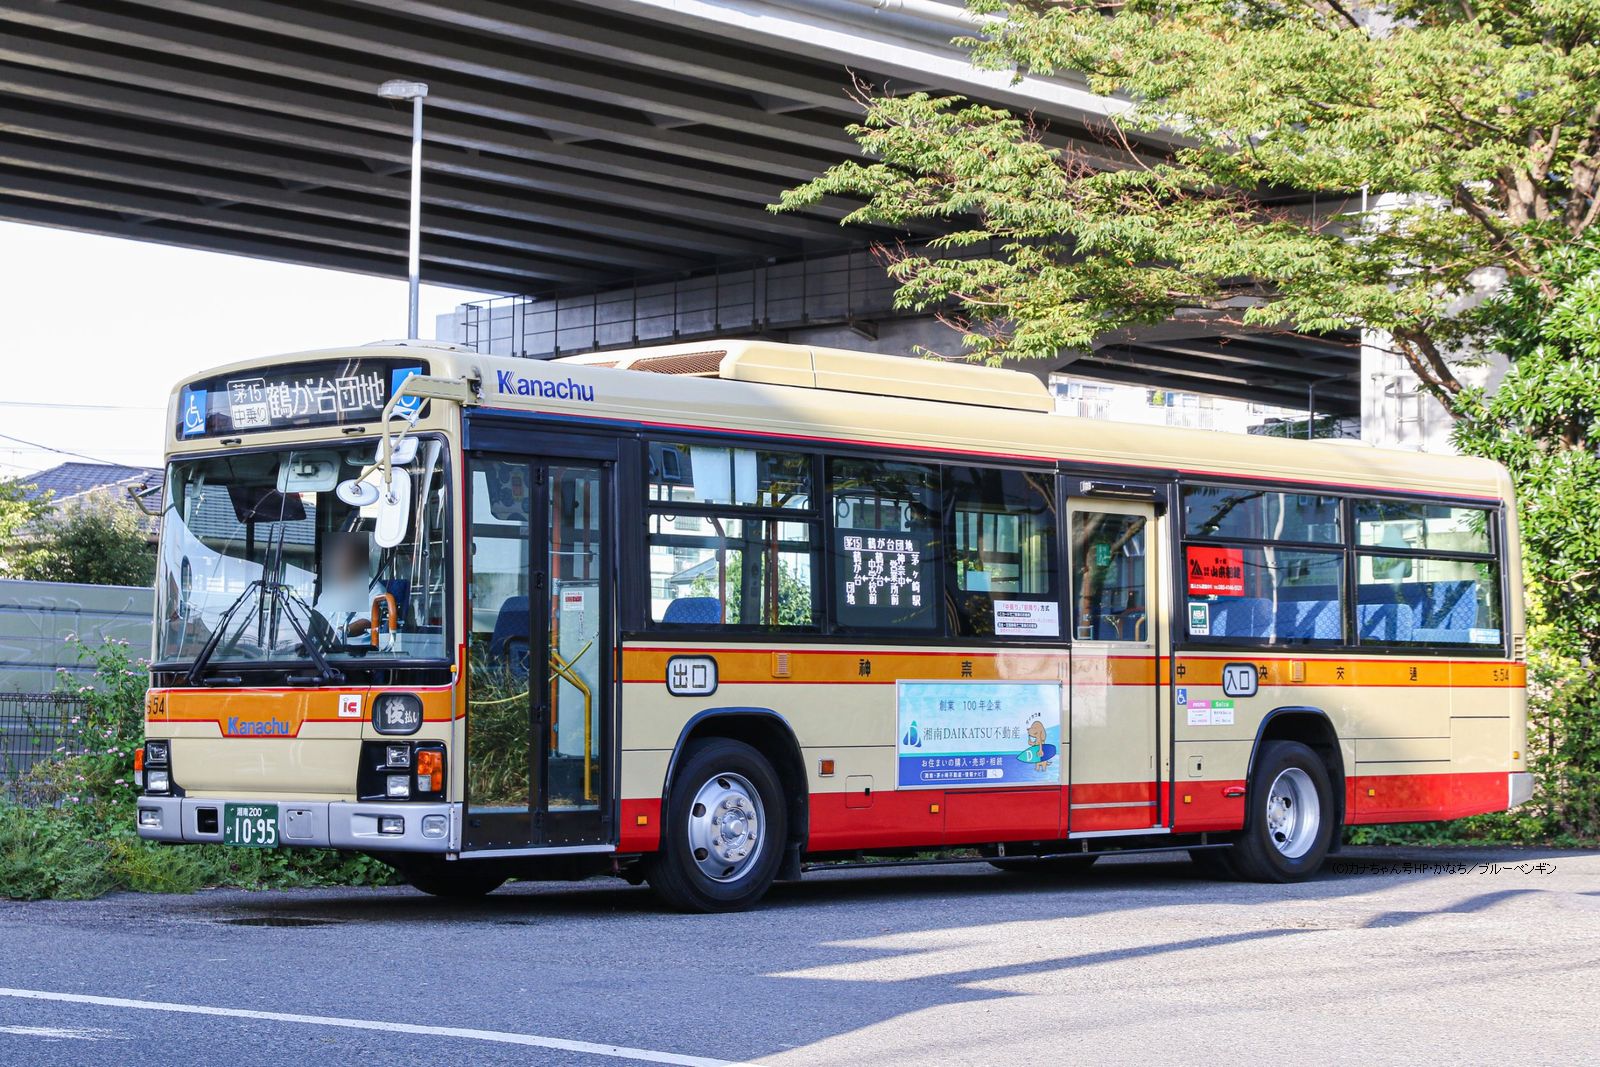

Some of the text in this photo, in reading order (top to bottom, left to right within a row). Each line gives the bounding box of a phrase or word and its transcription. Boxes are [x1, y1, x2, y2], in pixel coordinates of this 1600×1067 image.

[233, 383, 263, 403] 茅15
[267, 371, 385, 419] 鶴が台団地
[497, 370, 594, 401] Kanachu
[234, 407, 267, 425] 中乗り
[867, 537, 913, 552] 鶴が台団地
[673, 663, 707, 689] 出口
[1226, 669, 1250, 691] 入口
[227, 715, 289, 735] Kanachu
[923, 725, 1021, 741] 湘南DAIKATSU不動産
[235, 817, 276, 844] 10-95
